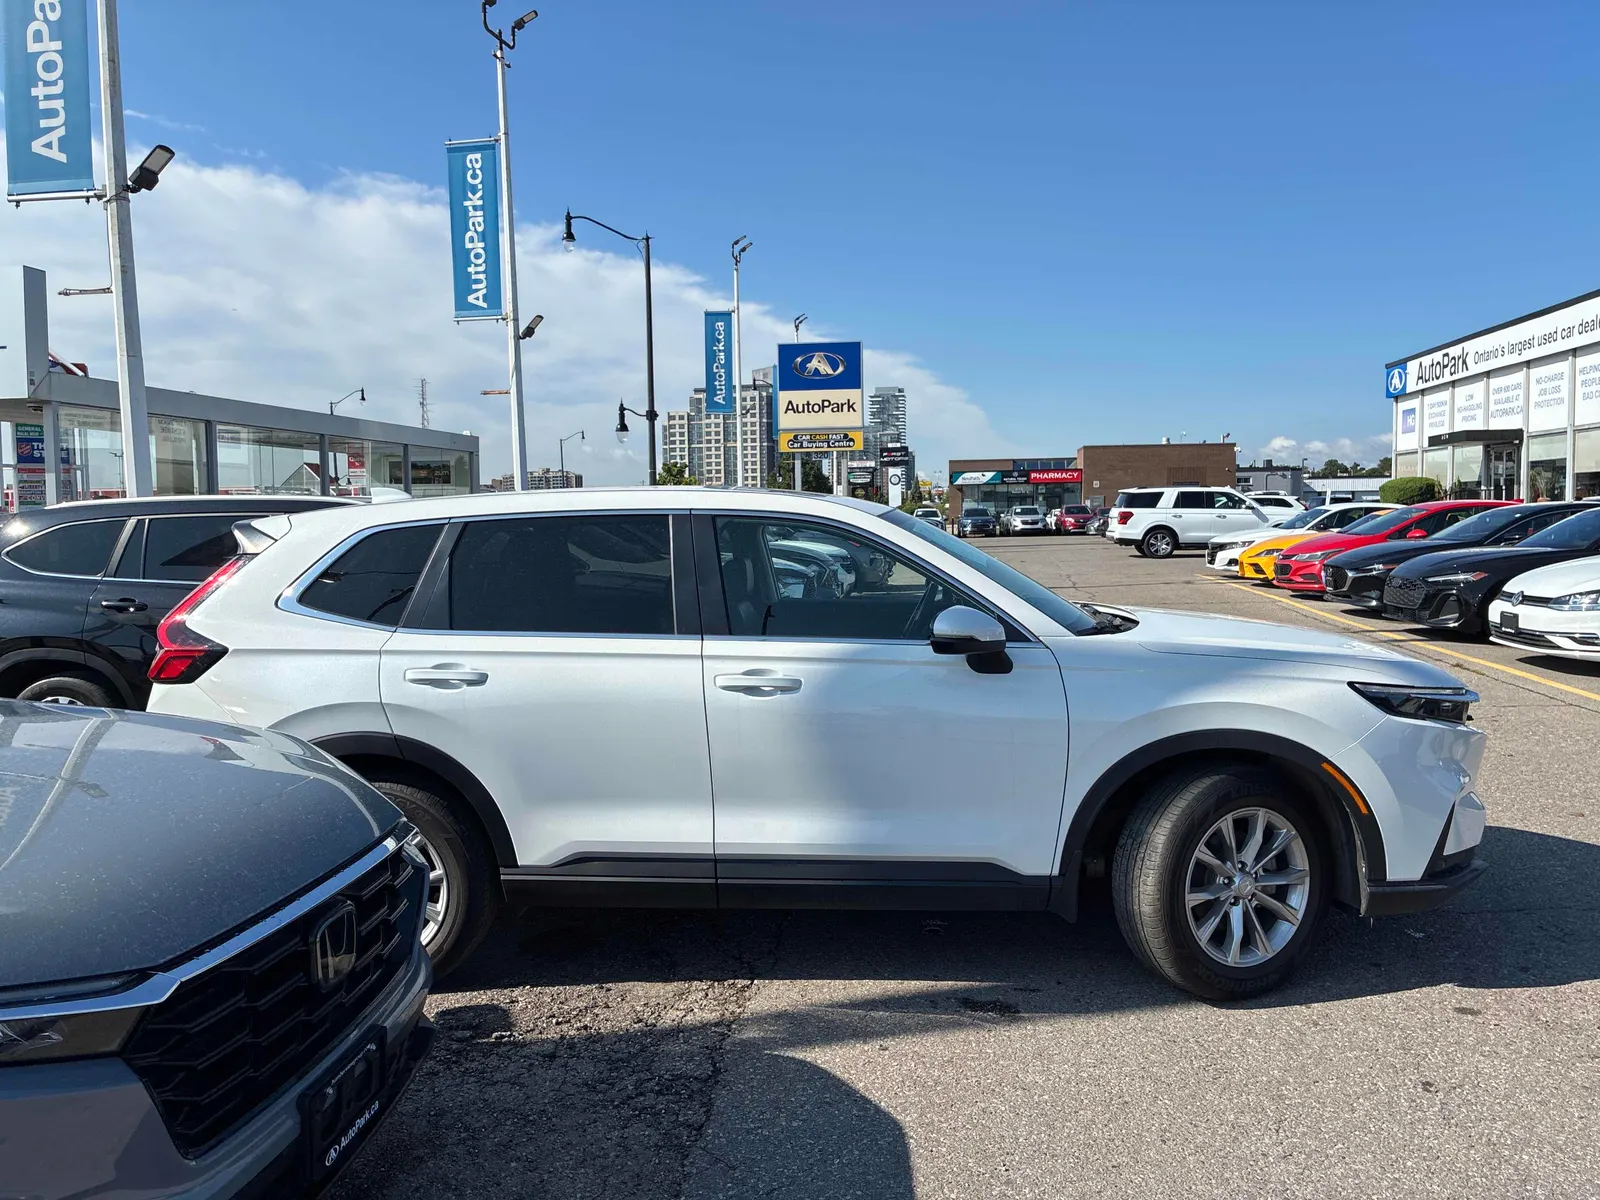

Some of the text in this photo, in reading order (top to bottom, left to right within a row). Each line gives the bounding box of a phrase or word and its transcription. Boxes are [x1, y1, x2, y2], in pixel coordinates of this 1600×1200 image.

[463, 152, 488, 309] AutoPark.ca
[1415, 346, 1470, 386] AutoPark
[1473, 343, 1506, 365] Ontario's
[1507, 336, 1535, 357] largest
[1537, 326, 1558, 346] used
[1561, 324, 1576, 340] car
[713, 321, 726, 405] AutoPark.ca
[1535, 371, 1565, 385] NO-CHARGE
[1538, 385, 1562, 398] JOB LOSS
[784, 398, 857, 414] AutoPark
[1534, 396, 1565, 410] PROTECTION
[802, 441, 828, 449] Buying
[1030, 472, 1079, 480] PHARMACY
[340, 1100, 379, 1151] AutoPark.ca
